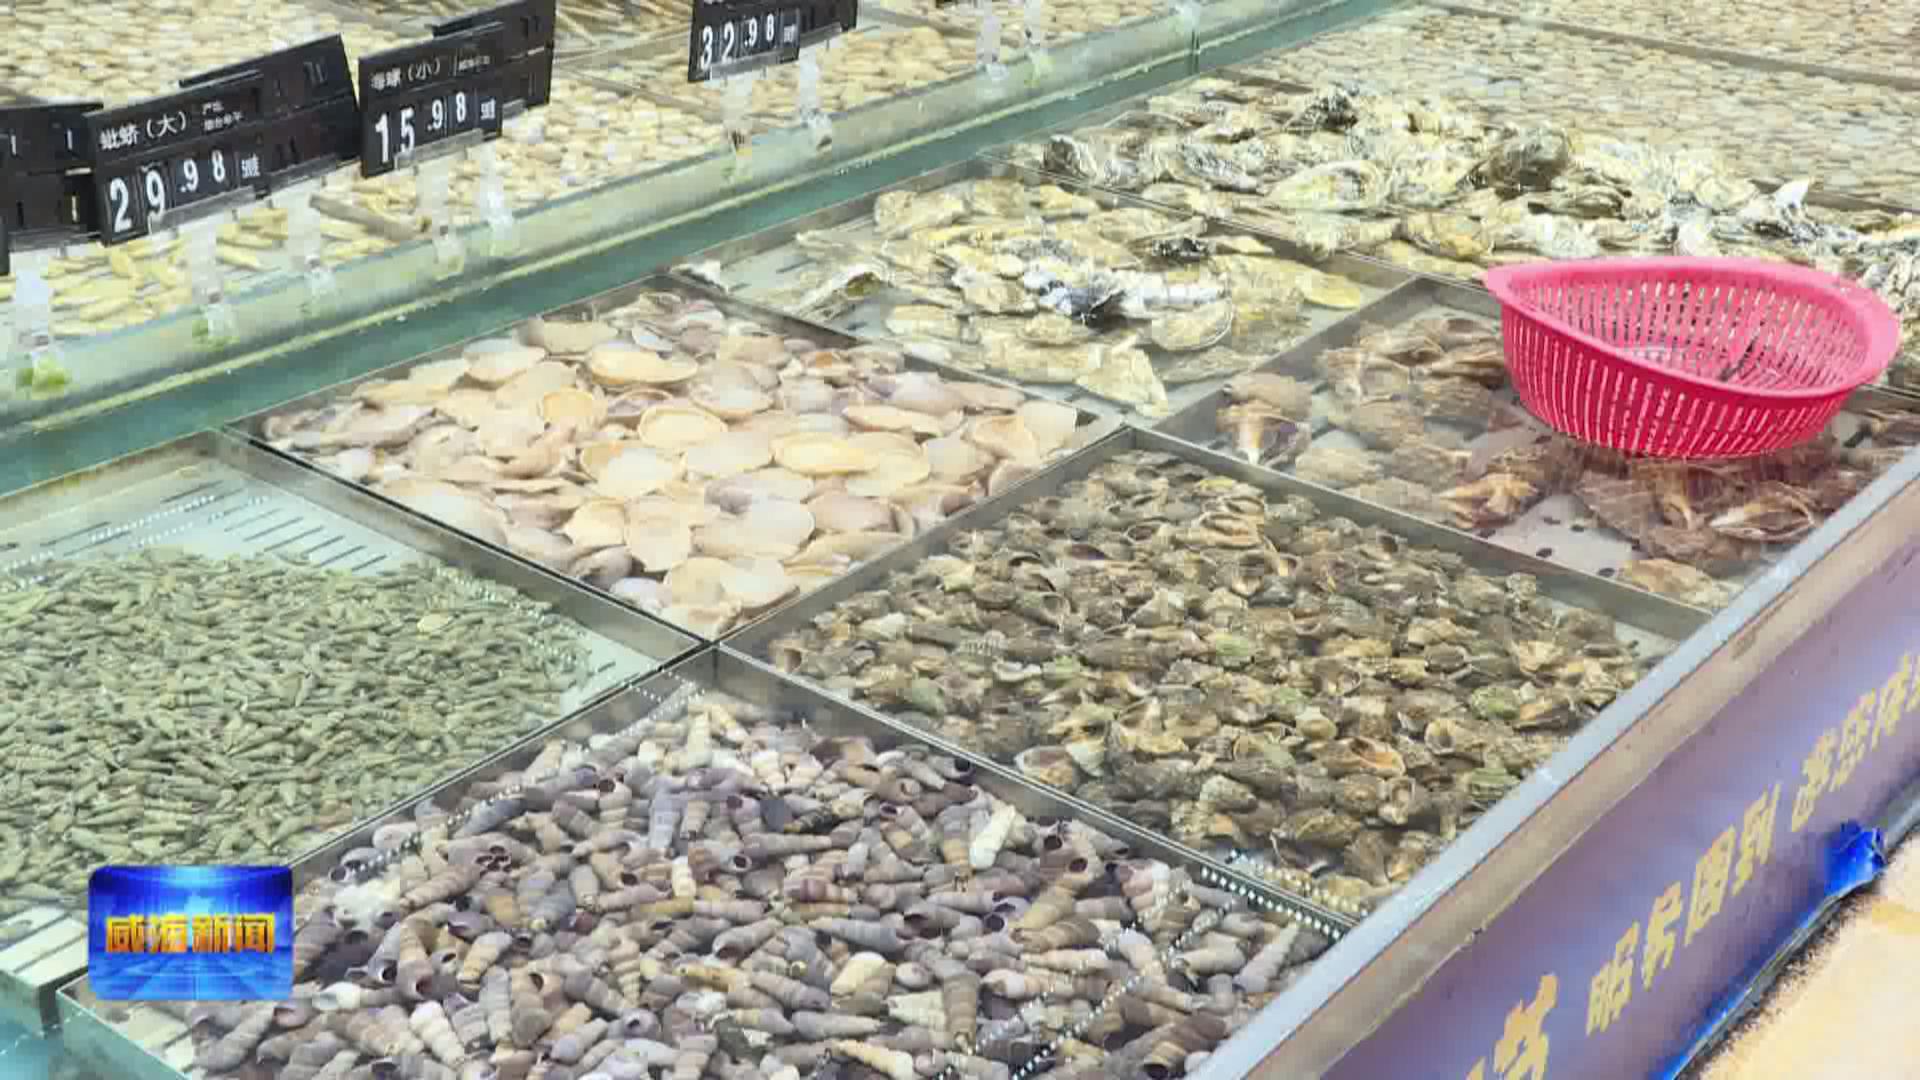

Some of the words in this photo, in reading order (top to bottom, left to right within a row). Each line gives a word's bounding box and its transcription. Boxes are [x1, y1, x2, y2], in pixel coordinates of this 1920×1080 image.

[700, 13, 774, 70] 32.98
[375, 91, 467, 164] 15.98
[110, 150, 226, 233] 29.98
